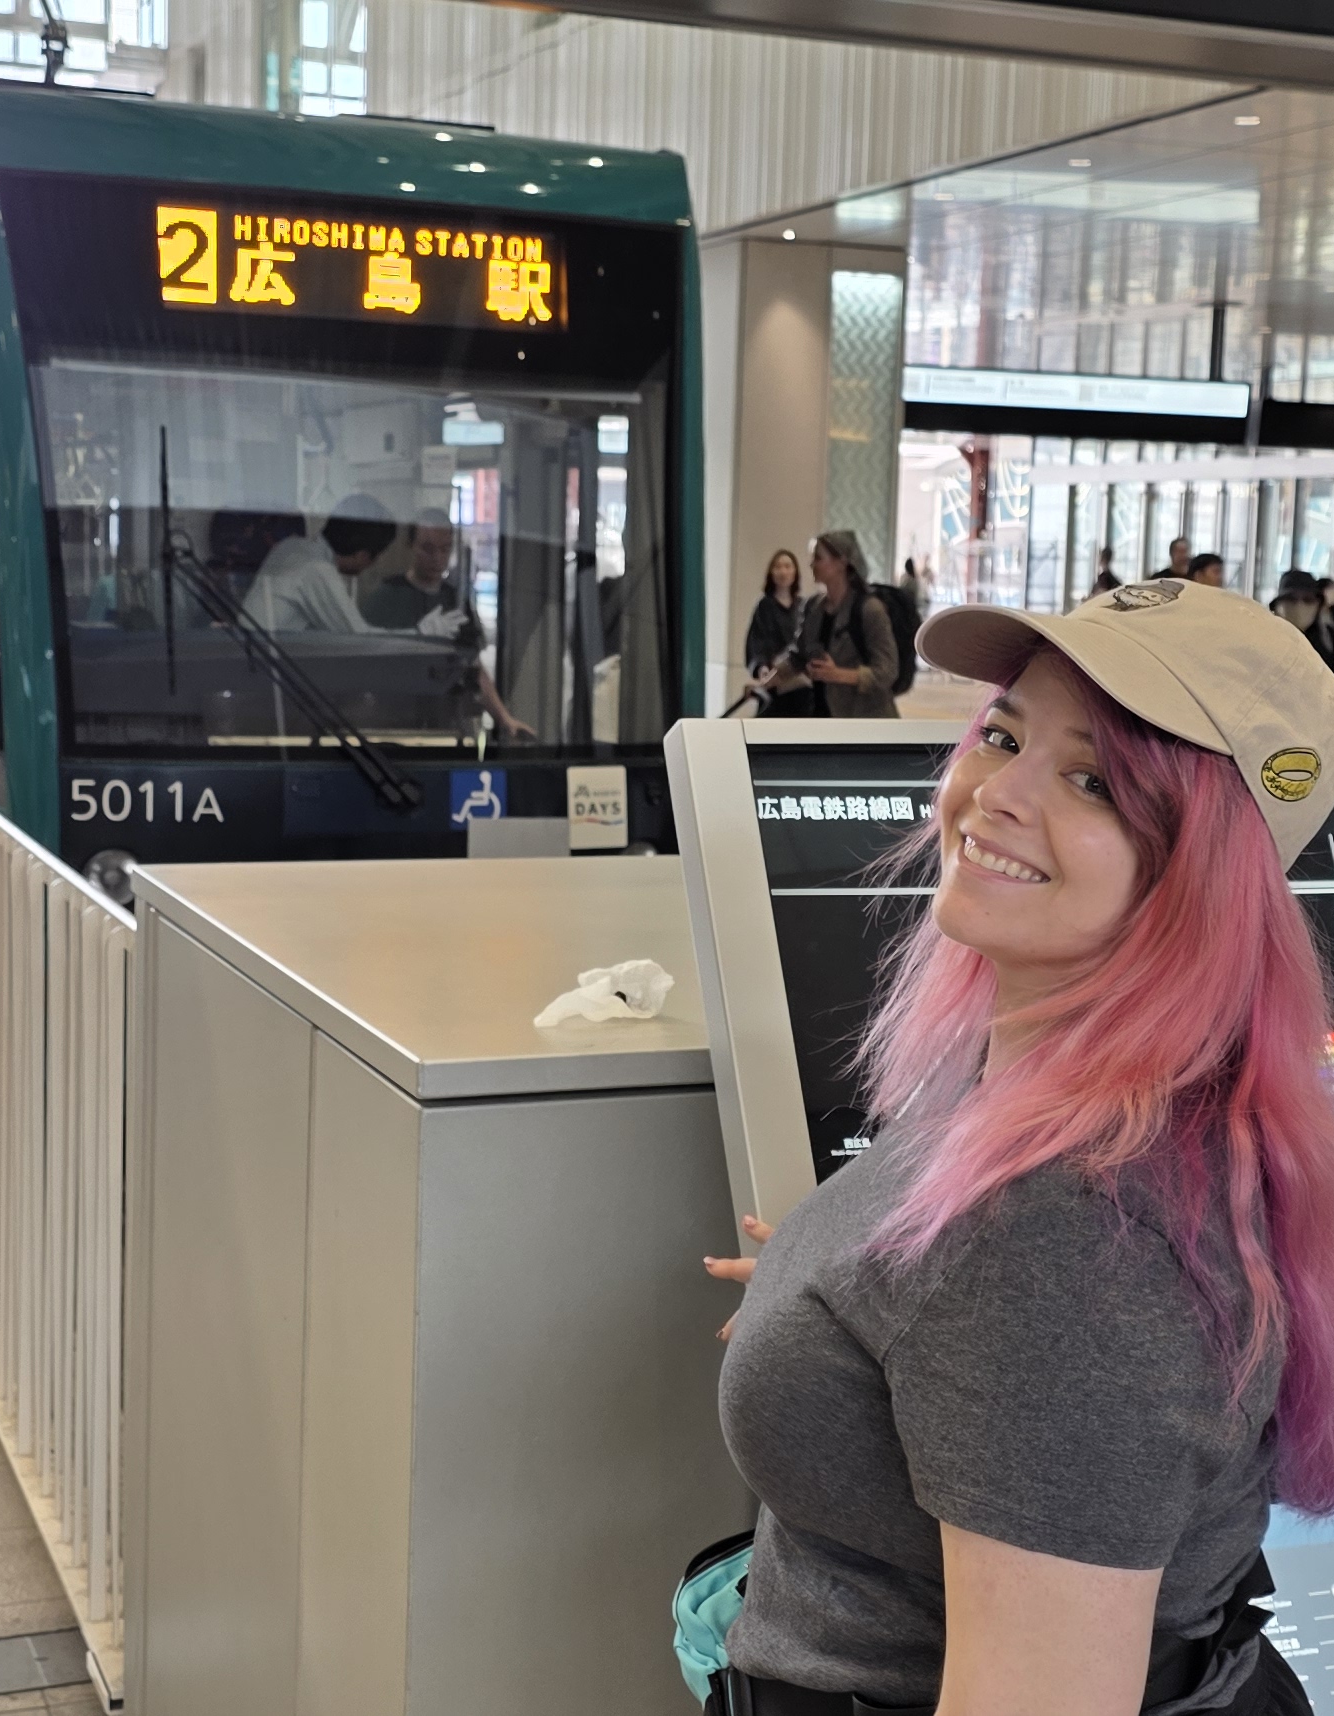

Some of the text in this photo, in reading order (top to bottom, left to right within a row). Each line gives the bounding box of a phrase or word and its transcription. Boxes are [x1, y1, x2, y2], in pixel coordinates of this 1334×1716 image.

[158, 219, 210, 292] 2
[233, 214, 543, 264] HIROSHIMA STATION
[70, 778, 224, 823] 5011A
[574, 801, 622, 817] DAYS
[757, 796, 915, 821] 広島電鉄路線図
